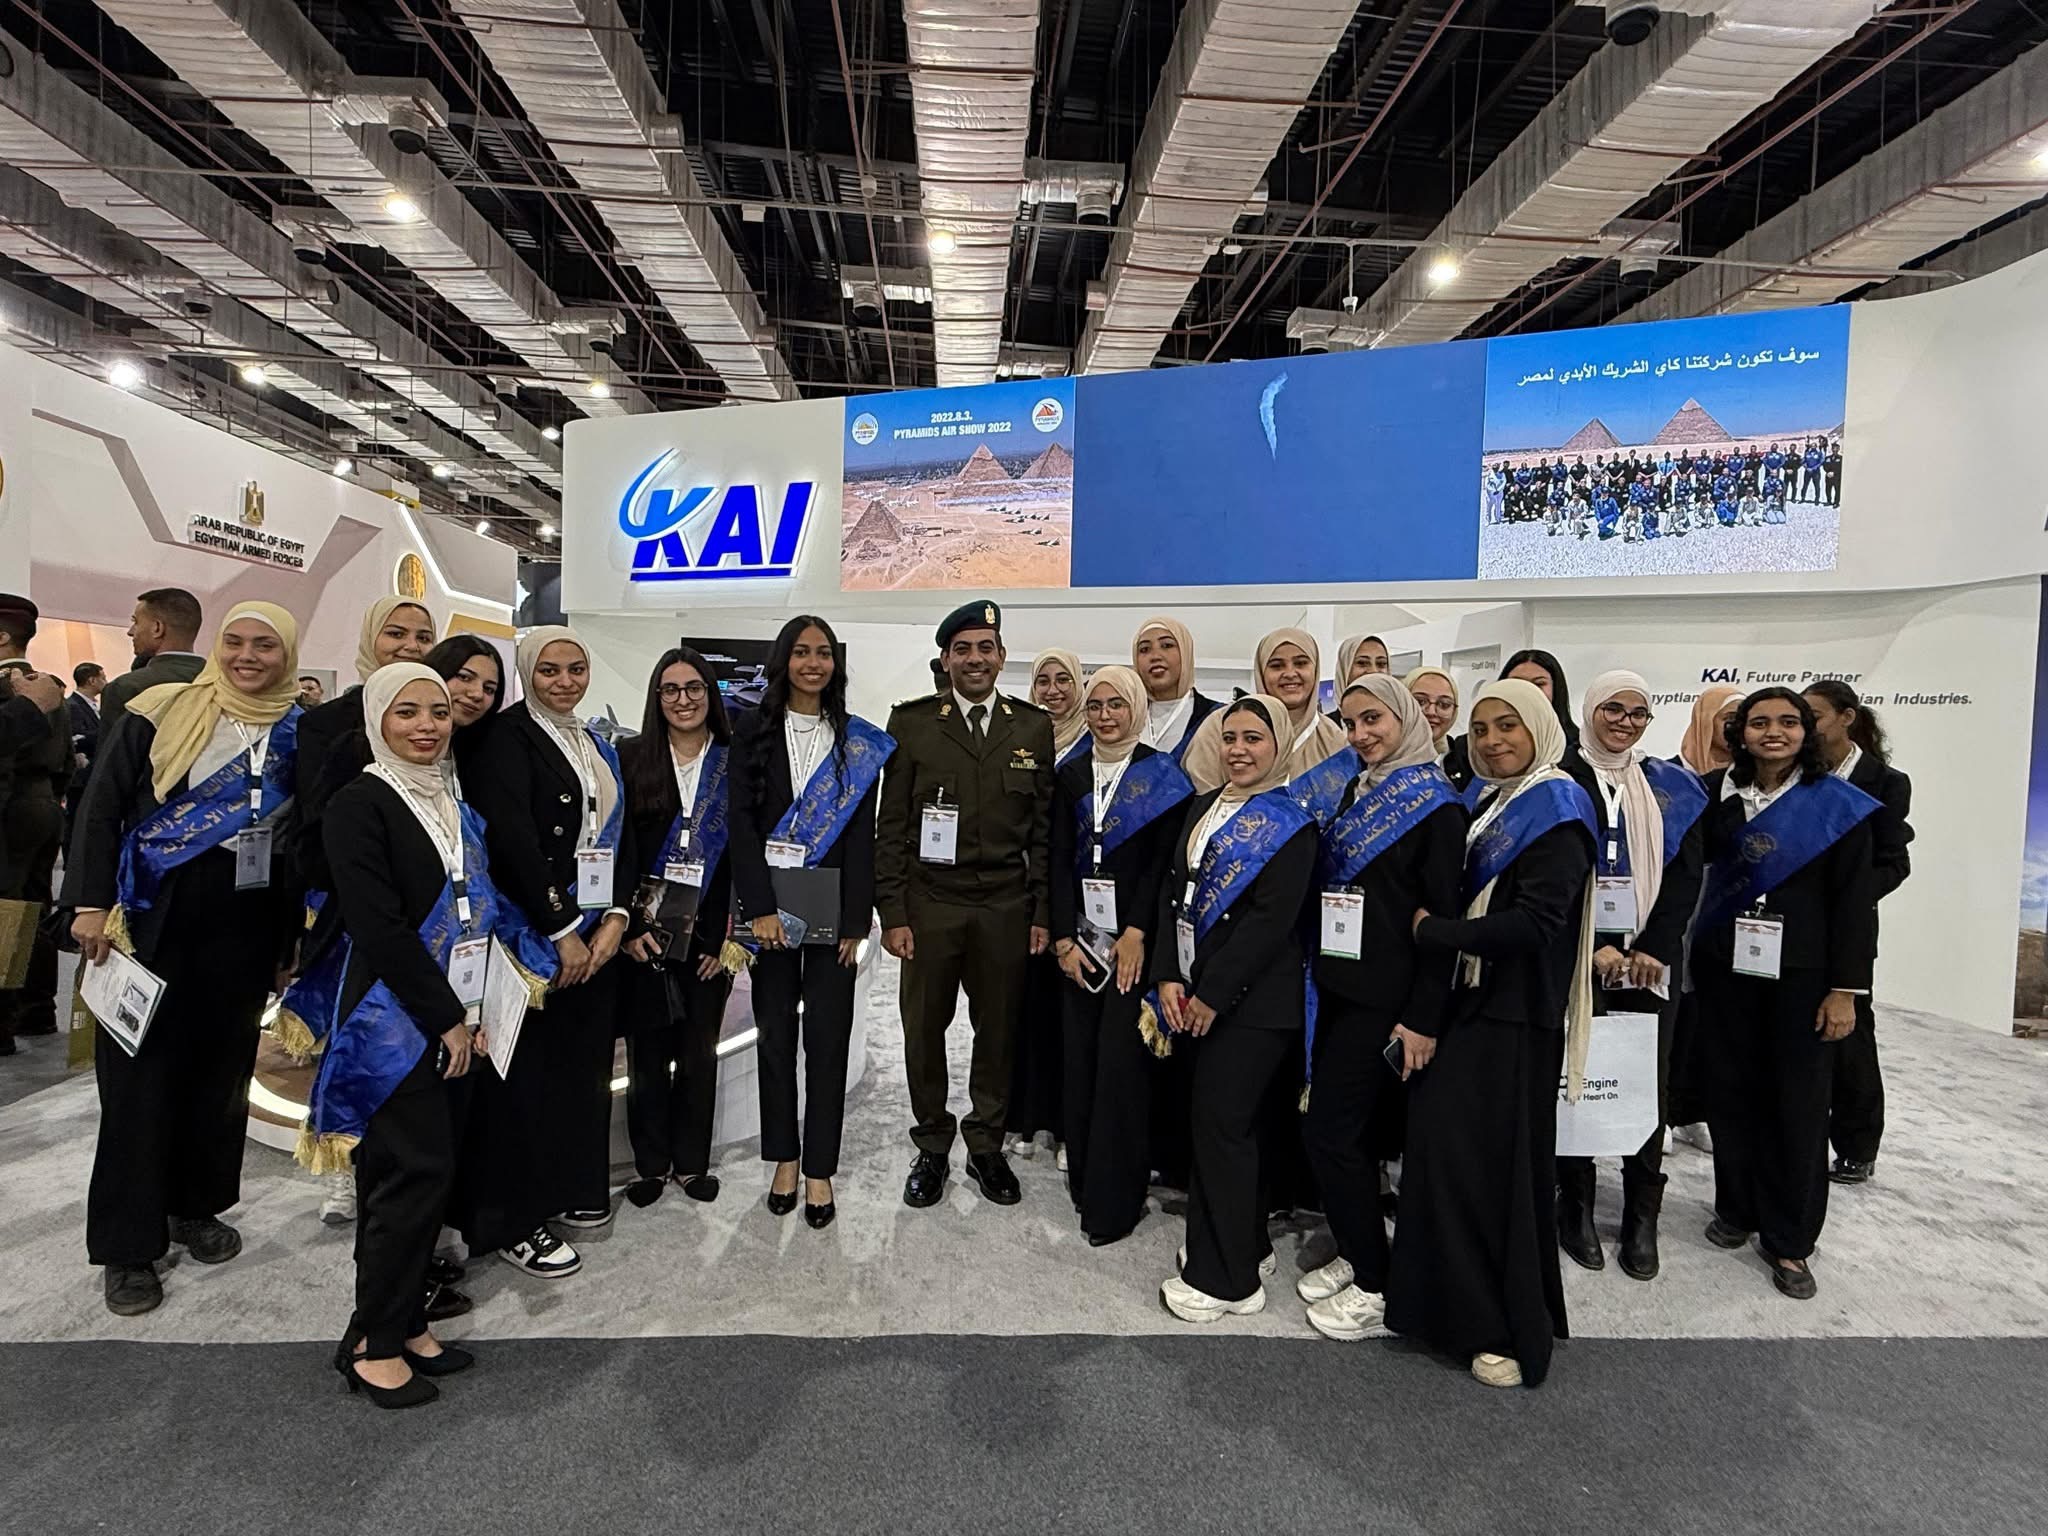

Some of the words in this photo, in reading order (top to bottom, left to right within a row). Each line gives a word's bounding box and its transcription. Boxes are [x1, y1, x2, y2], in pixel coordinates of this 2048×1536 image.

[1686, 353, 1732, 371] شركتنا
[1737, 350, 1774, 369] تكون
[1778, 347, 1820, 363] سوف
[1559, 363, 1598, 385] الأبدي
[1601, 361, 1649, 379] الشريك
[1655, 358, 1682, 376] كاي
[1517, 367, 1554, 388] لمصر
[931, 411, 973, 424] 2022.8.3.
[893, 427, 940, 440] PYRAMIDS
[941, 425, 957, 437] AIR
[959, 423, 986, 435] SHOW
[987, 421, 1012, 433] 2022
[193, 514, 222, 532] ARAB
[224, 522, 266, 545] REPUBLIC
[267, 535, 279, 547] OF
[280, 540, 305, 555] EGYPT
[619, 481, 817, 571] KAI
[194, 531, 240, 552] EGYPTIAN
[241, 544, 271, 561] ARMED
[273, 552, 304, 568] FORCES
[1701, 668, 1740, 685] KAI,
[1746, 671, 1797, 683] Future
[1801, 671, 1863, 683] Partner
[1894, 692, 1972, 705] Industries.
[1582, 1077, 1618, 1091] Engine
[1583, 1093, 1605, 1101] Heart
[1607, 1092, 1619, 1101] On
